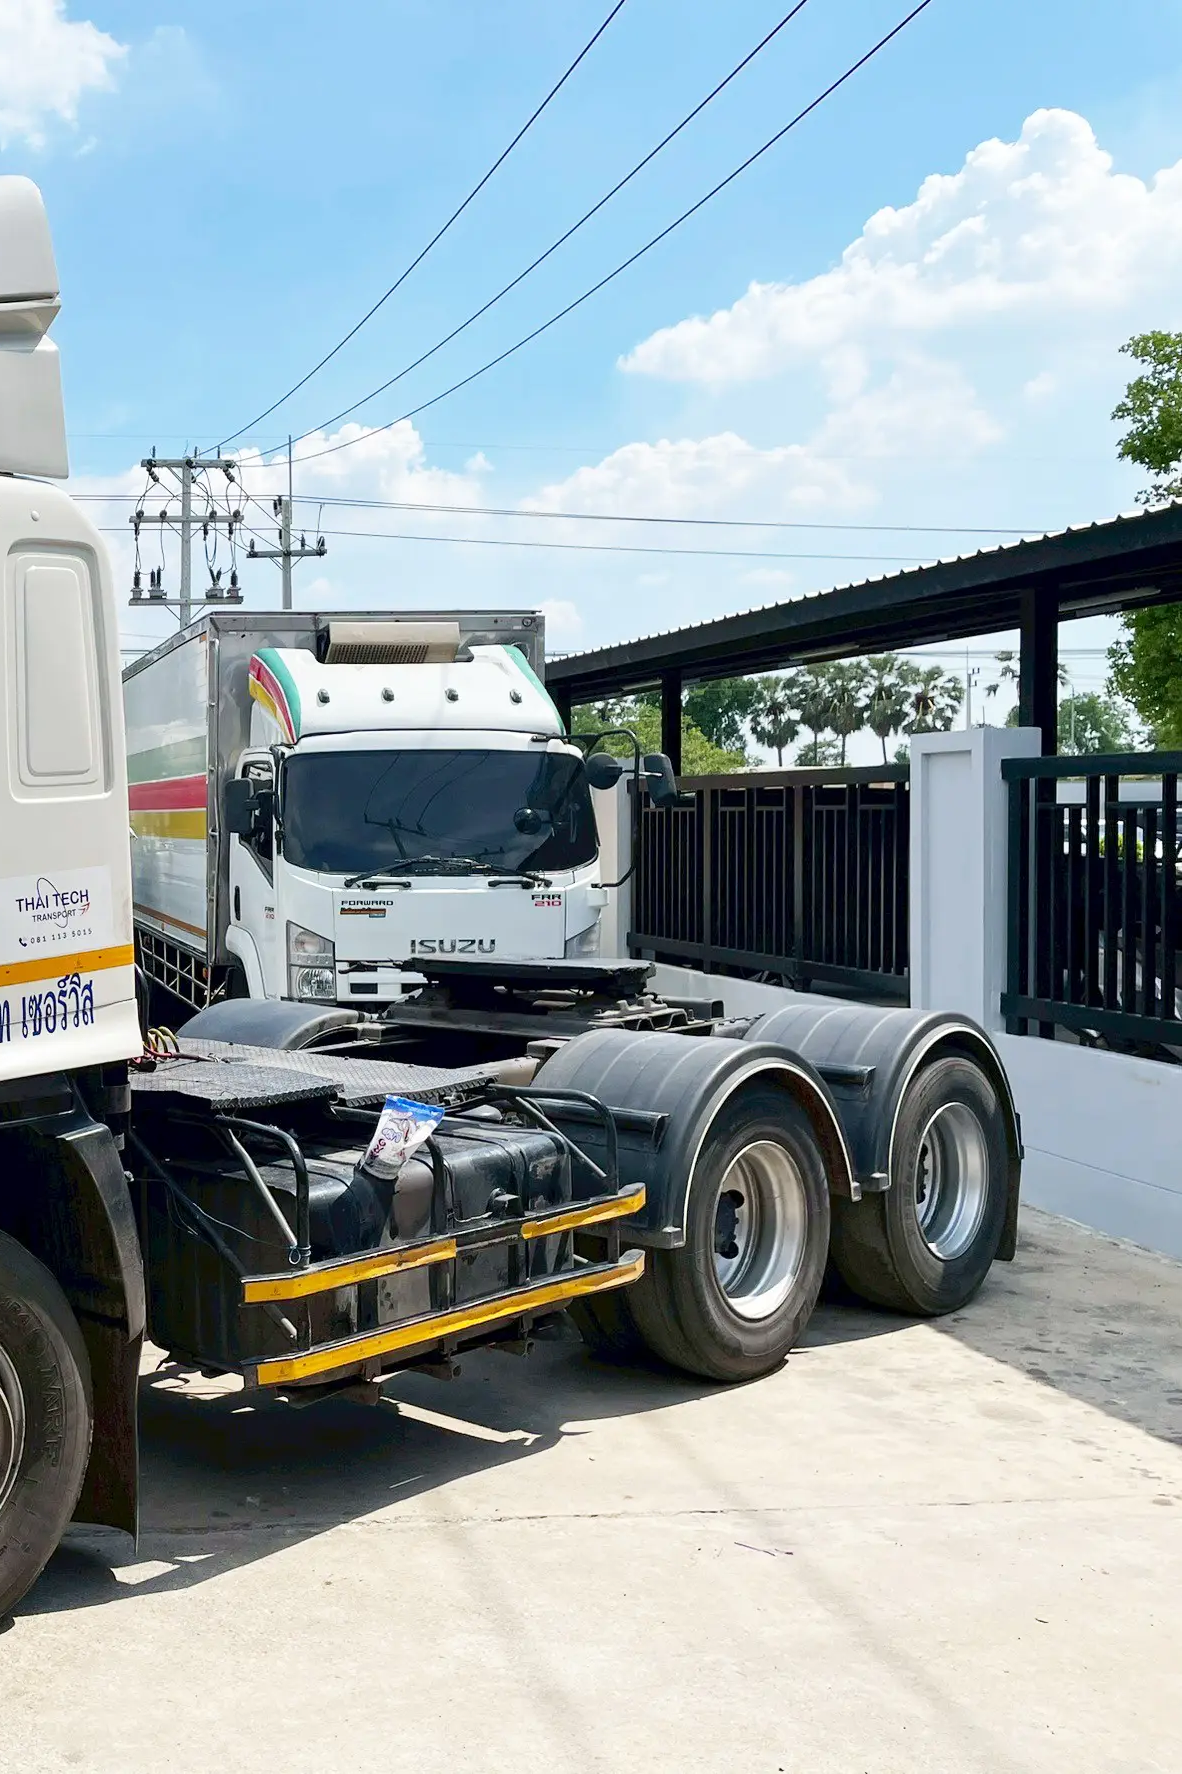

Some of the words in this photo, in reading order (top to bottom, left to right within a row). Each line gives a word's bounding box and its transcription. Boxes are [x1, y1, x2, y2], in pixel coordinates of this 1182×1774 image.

[15, 894, 49, 913] THAI
[52, 888, 90, 907] TECH
[31, 908, 77, 923] TRANSPORT
[30, 935, 47, 944] 081
[51, 931, 68, 941] 113
[71, 927, 93, 938] 5015
[410, 938, 496, 954] ISUZU
